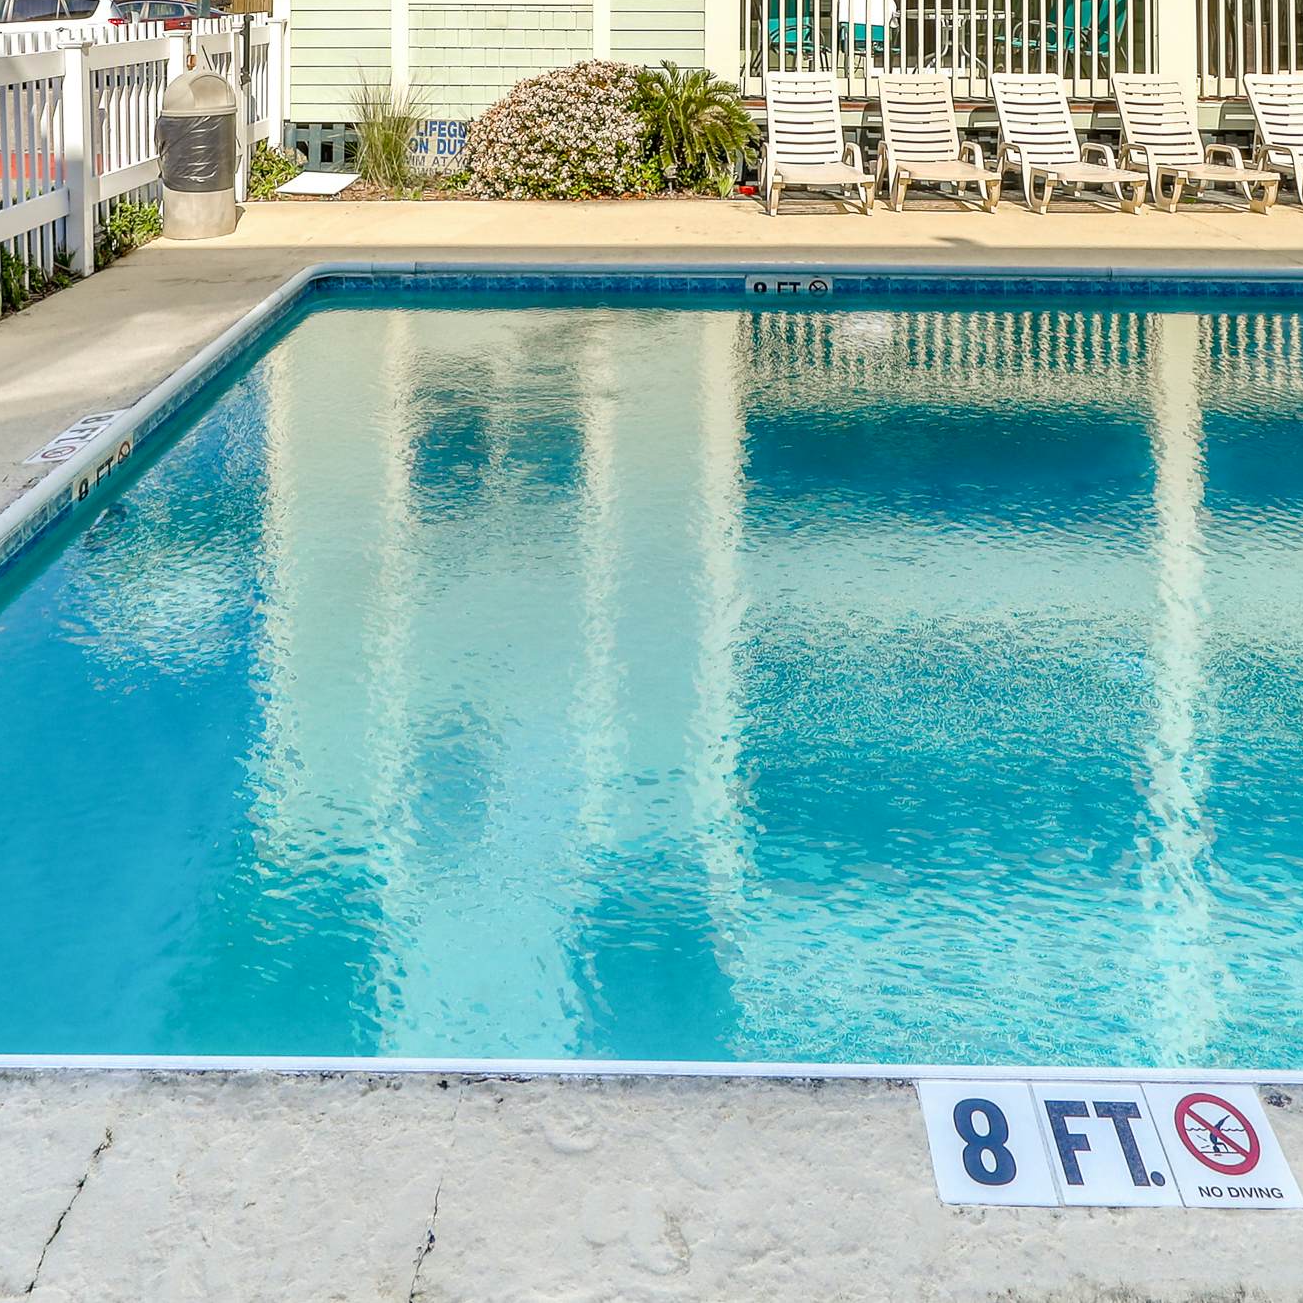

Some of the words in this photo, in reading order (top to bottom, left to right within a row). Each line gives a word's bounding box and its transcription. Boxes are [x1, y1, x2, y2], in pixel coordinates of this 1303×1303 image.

[409, 138, 429, 154] ON
[437, 138, 467, 156] DUT
[431, 156, 449, 167] AT
[96, 455, 114, 487] FT
[952, 1098, 1018, 1186] 8
[1043, 1099, 1167, 1187] FT.
[1197, 1185, 1224, 1198] NO
[1226, 1186, 1285, 1199] DIVING
